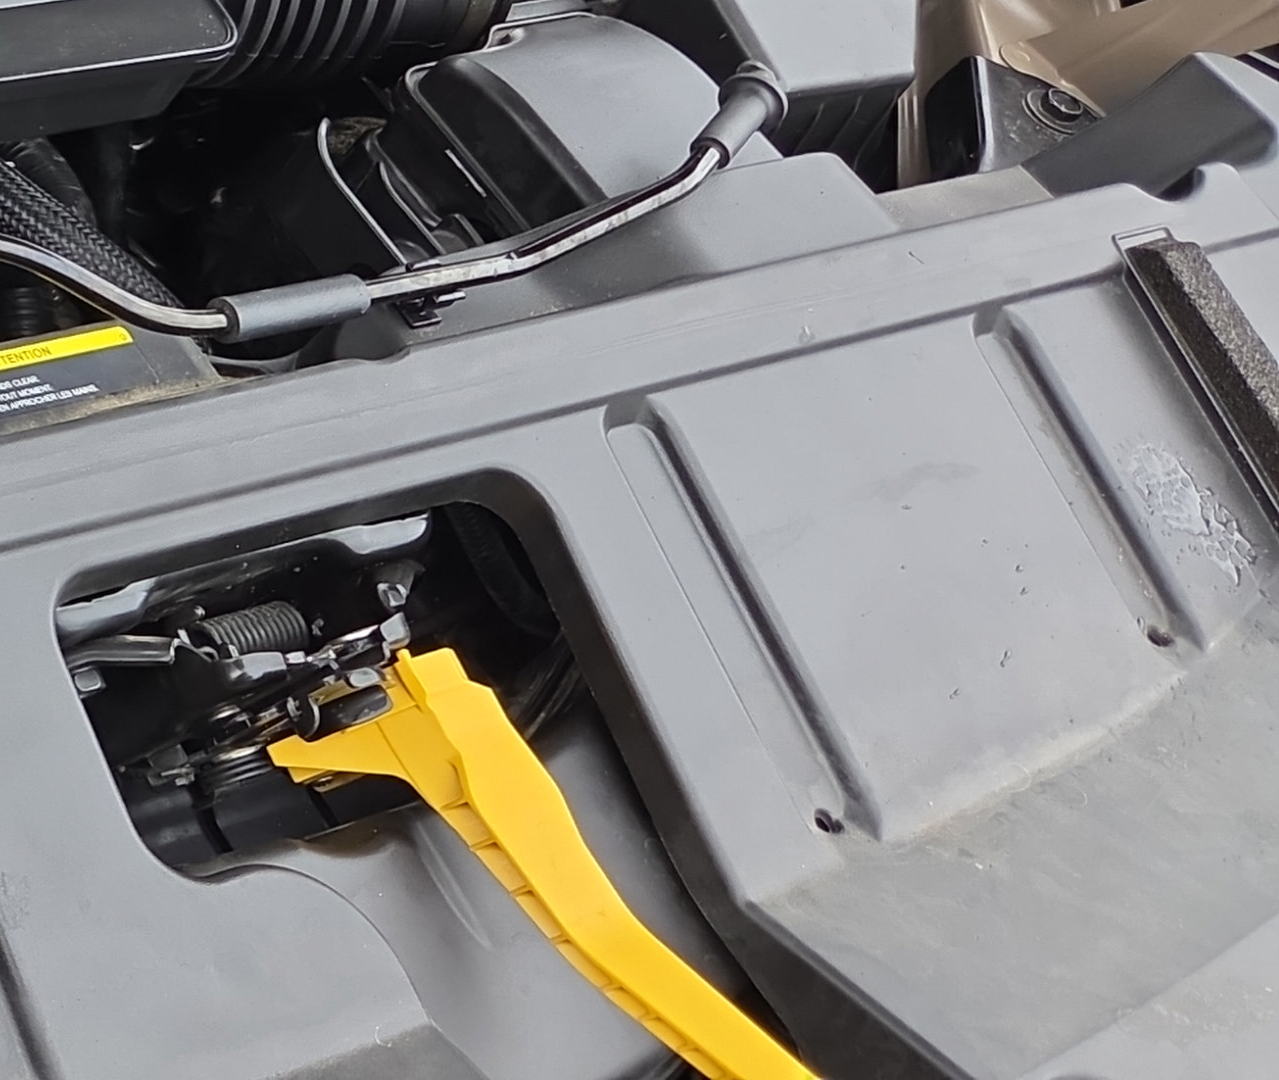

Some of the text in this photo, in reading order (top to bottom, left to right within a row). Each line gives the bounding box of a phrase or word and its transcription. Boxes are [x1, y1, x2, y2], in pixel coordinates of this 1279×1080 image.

[0, 401, 11, 412] EN
[10, 392, 58, 410] APPROCHER
[57, 389, 72, 400] LES
